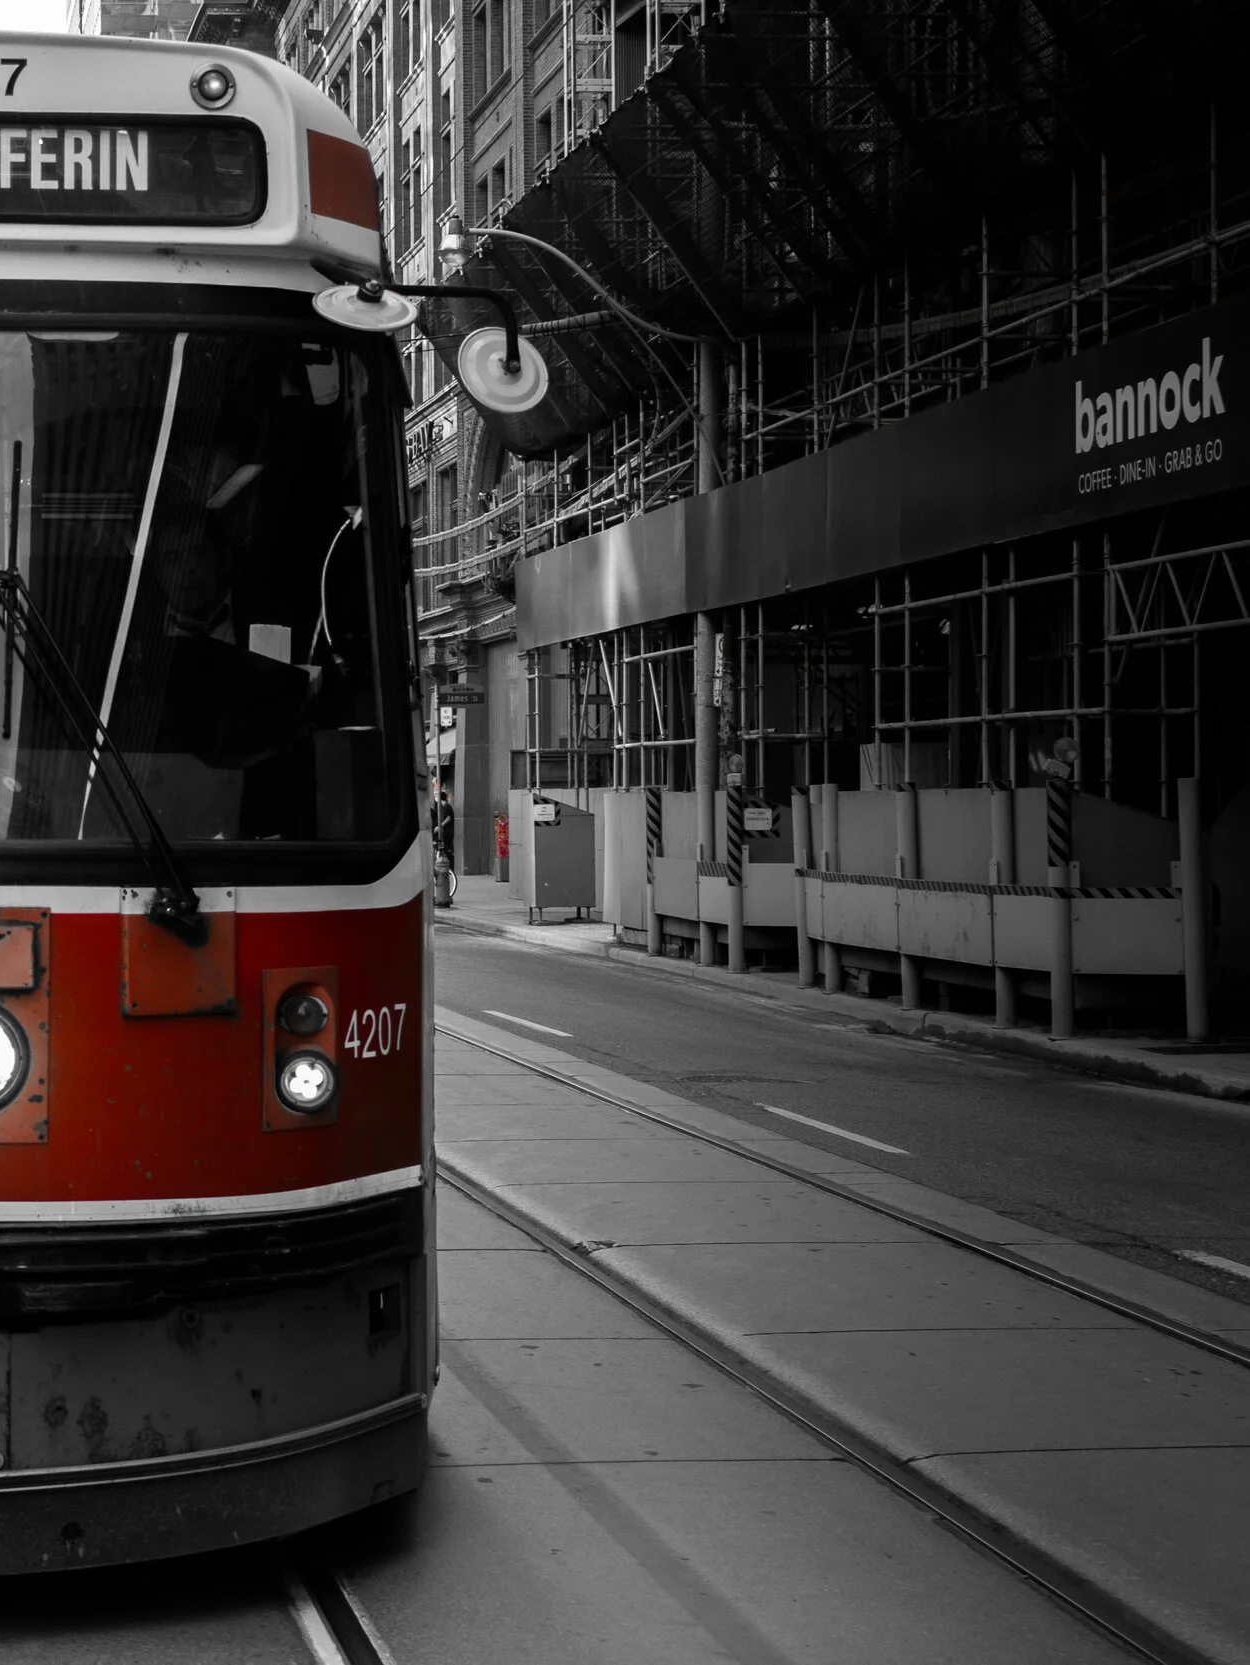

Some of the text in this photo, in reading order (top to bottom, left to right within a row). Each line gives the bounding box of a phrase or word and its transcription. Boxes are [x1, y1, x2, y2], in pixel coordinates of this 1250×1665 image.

[1075, 336, 1226, 454] bannock
[1078, 438, 1223, 494] COFFEE DINE-IN GRAB & GO
[446, 694, 469, 702] James
[344, 1003, 407, 1059] 4207
